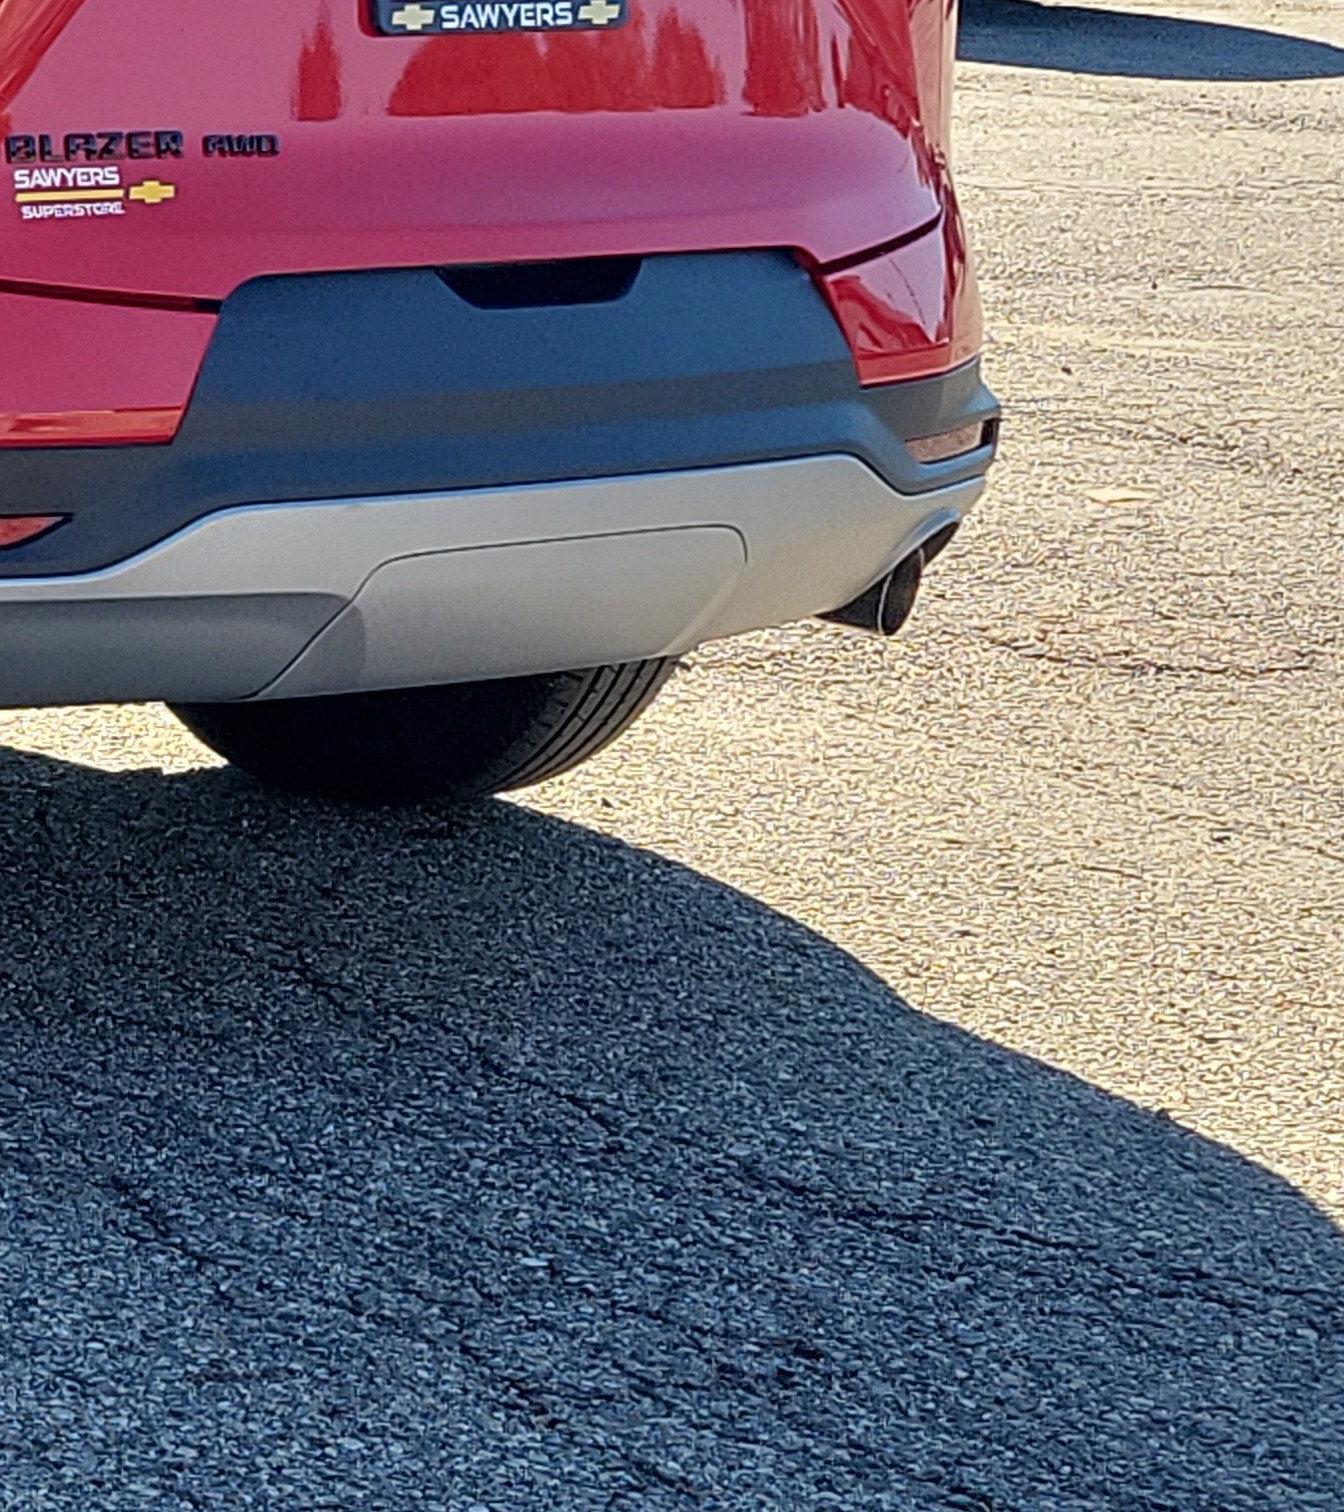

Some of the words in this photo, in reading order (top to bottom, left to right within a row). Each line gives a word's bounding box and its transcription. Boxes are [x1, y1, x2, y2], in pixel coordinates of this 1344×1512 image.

[440, 2, 573, 29] SAWYERS
[5, 131, 184, 164] BLAZER
[203, 134, 281, 157] AWD
[14, 167, 120, 189] SAWYERS
[20, 201, 126, 220] SUPERSTORE
